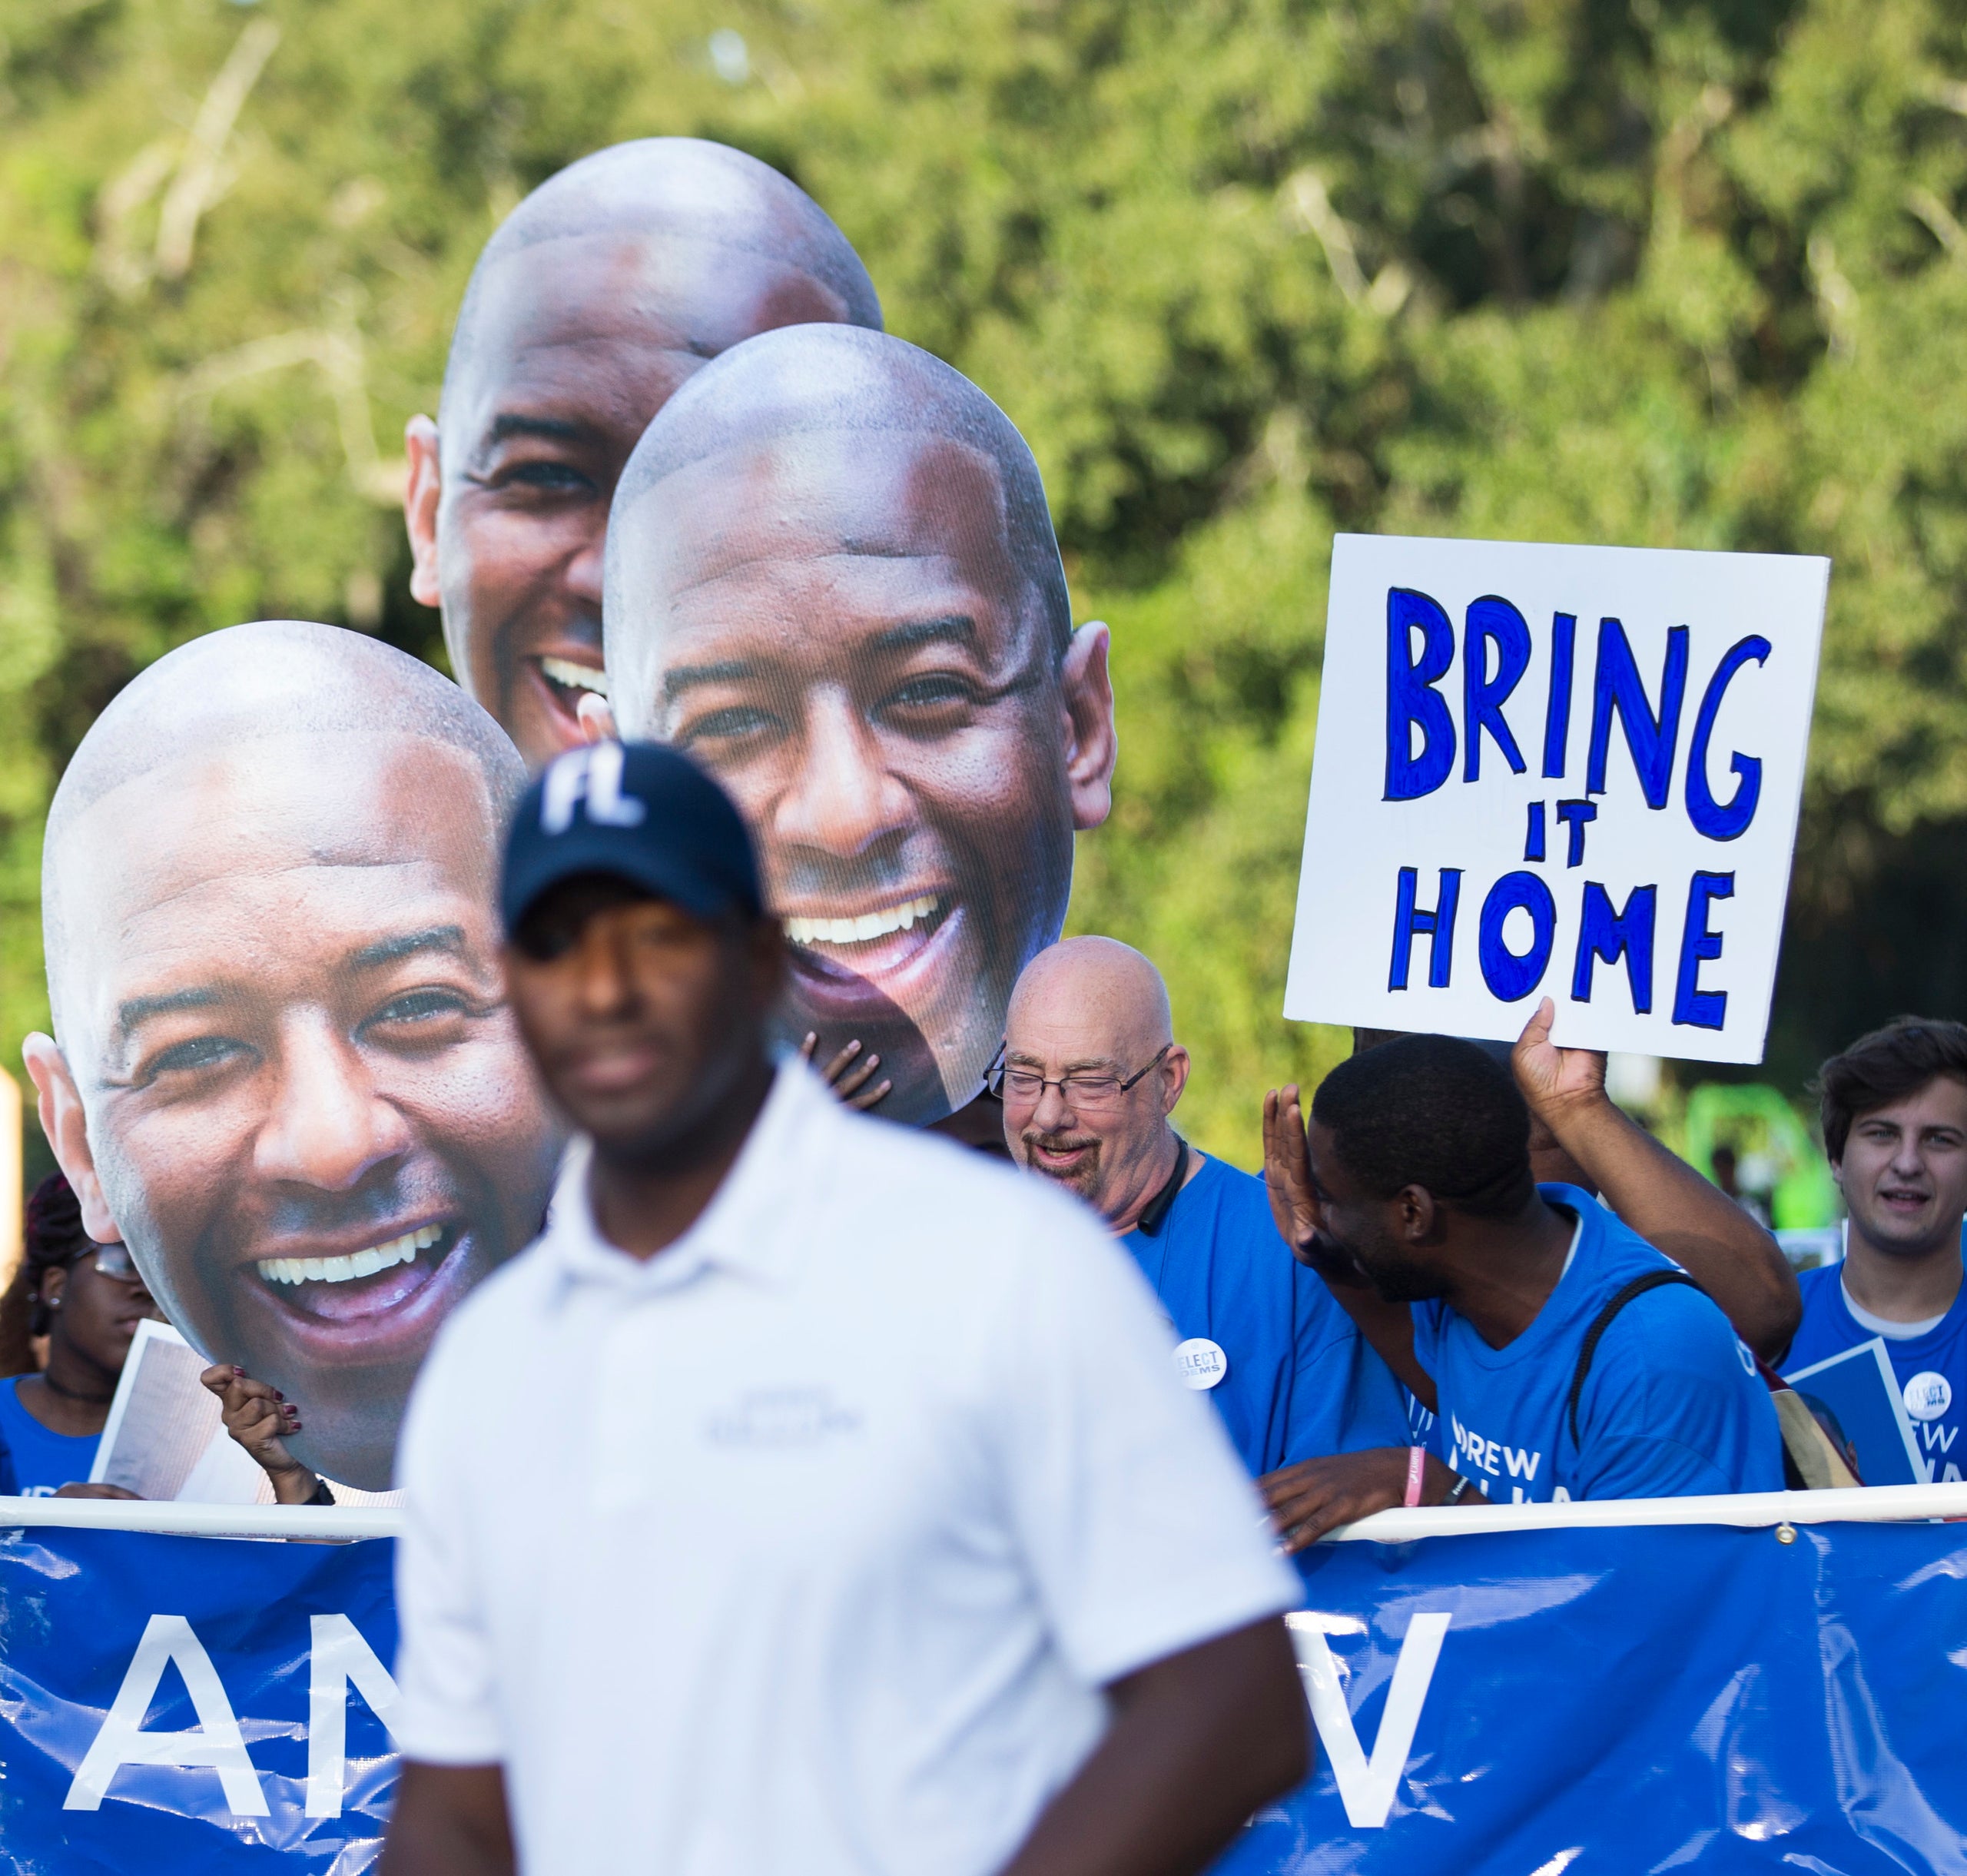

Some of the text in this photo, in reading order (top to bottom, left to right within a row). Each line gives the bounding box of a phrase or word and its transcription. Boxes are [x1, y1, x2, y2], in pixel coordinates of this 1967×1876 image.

[1382, 586, 1772, 842] BRING
[1524, 799, 1597, 869] IT
[1388, 866, 1736, 1031] HOME
